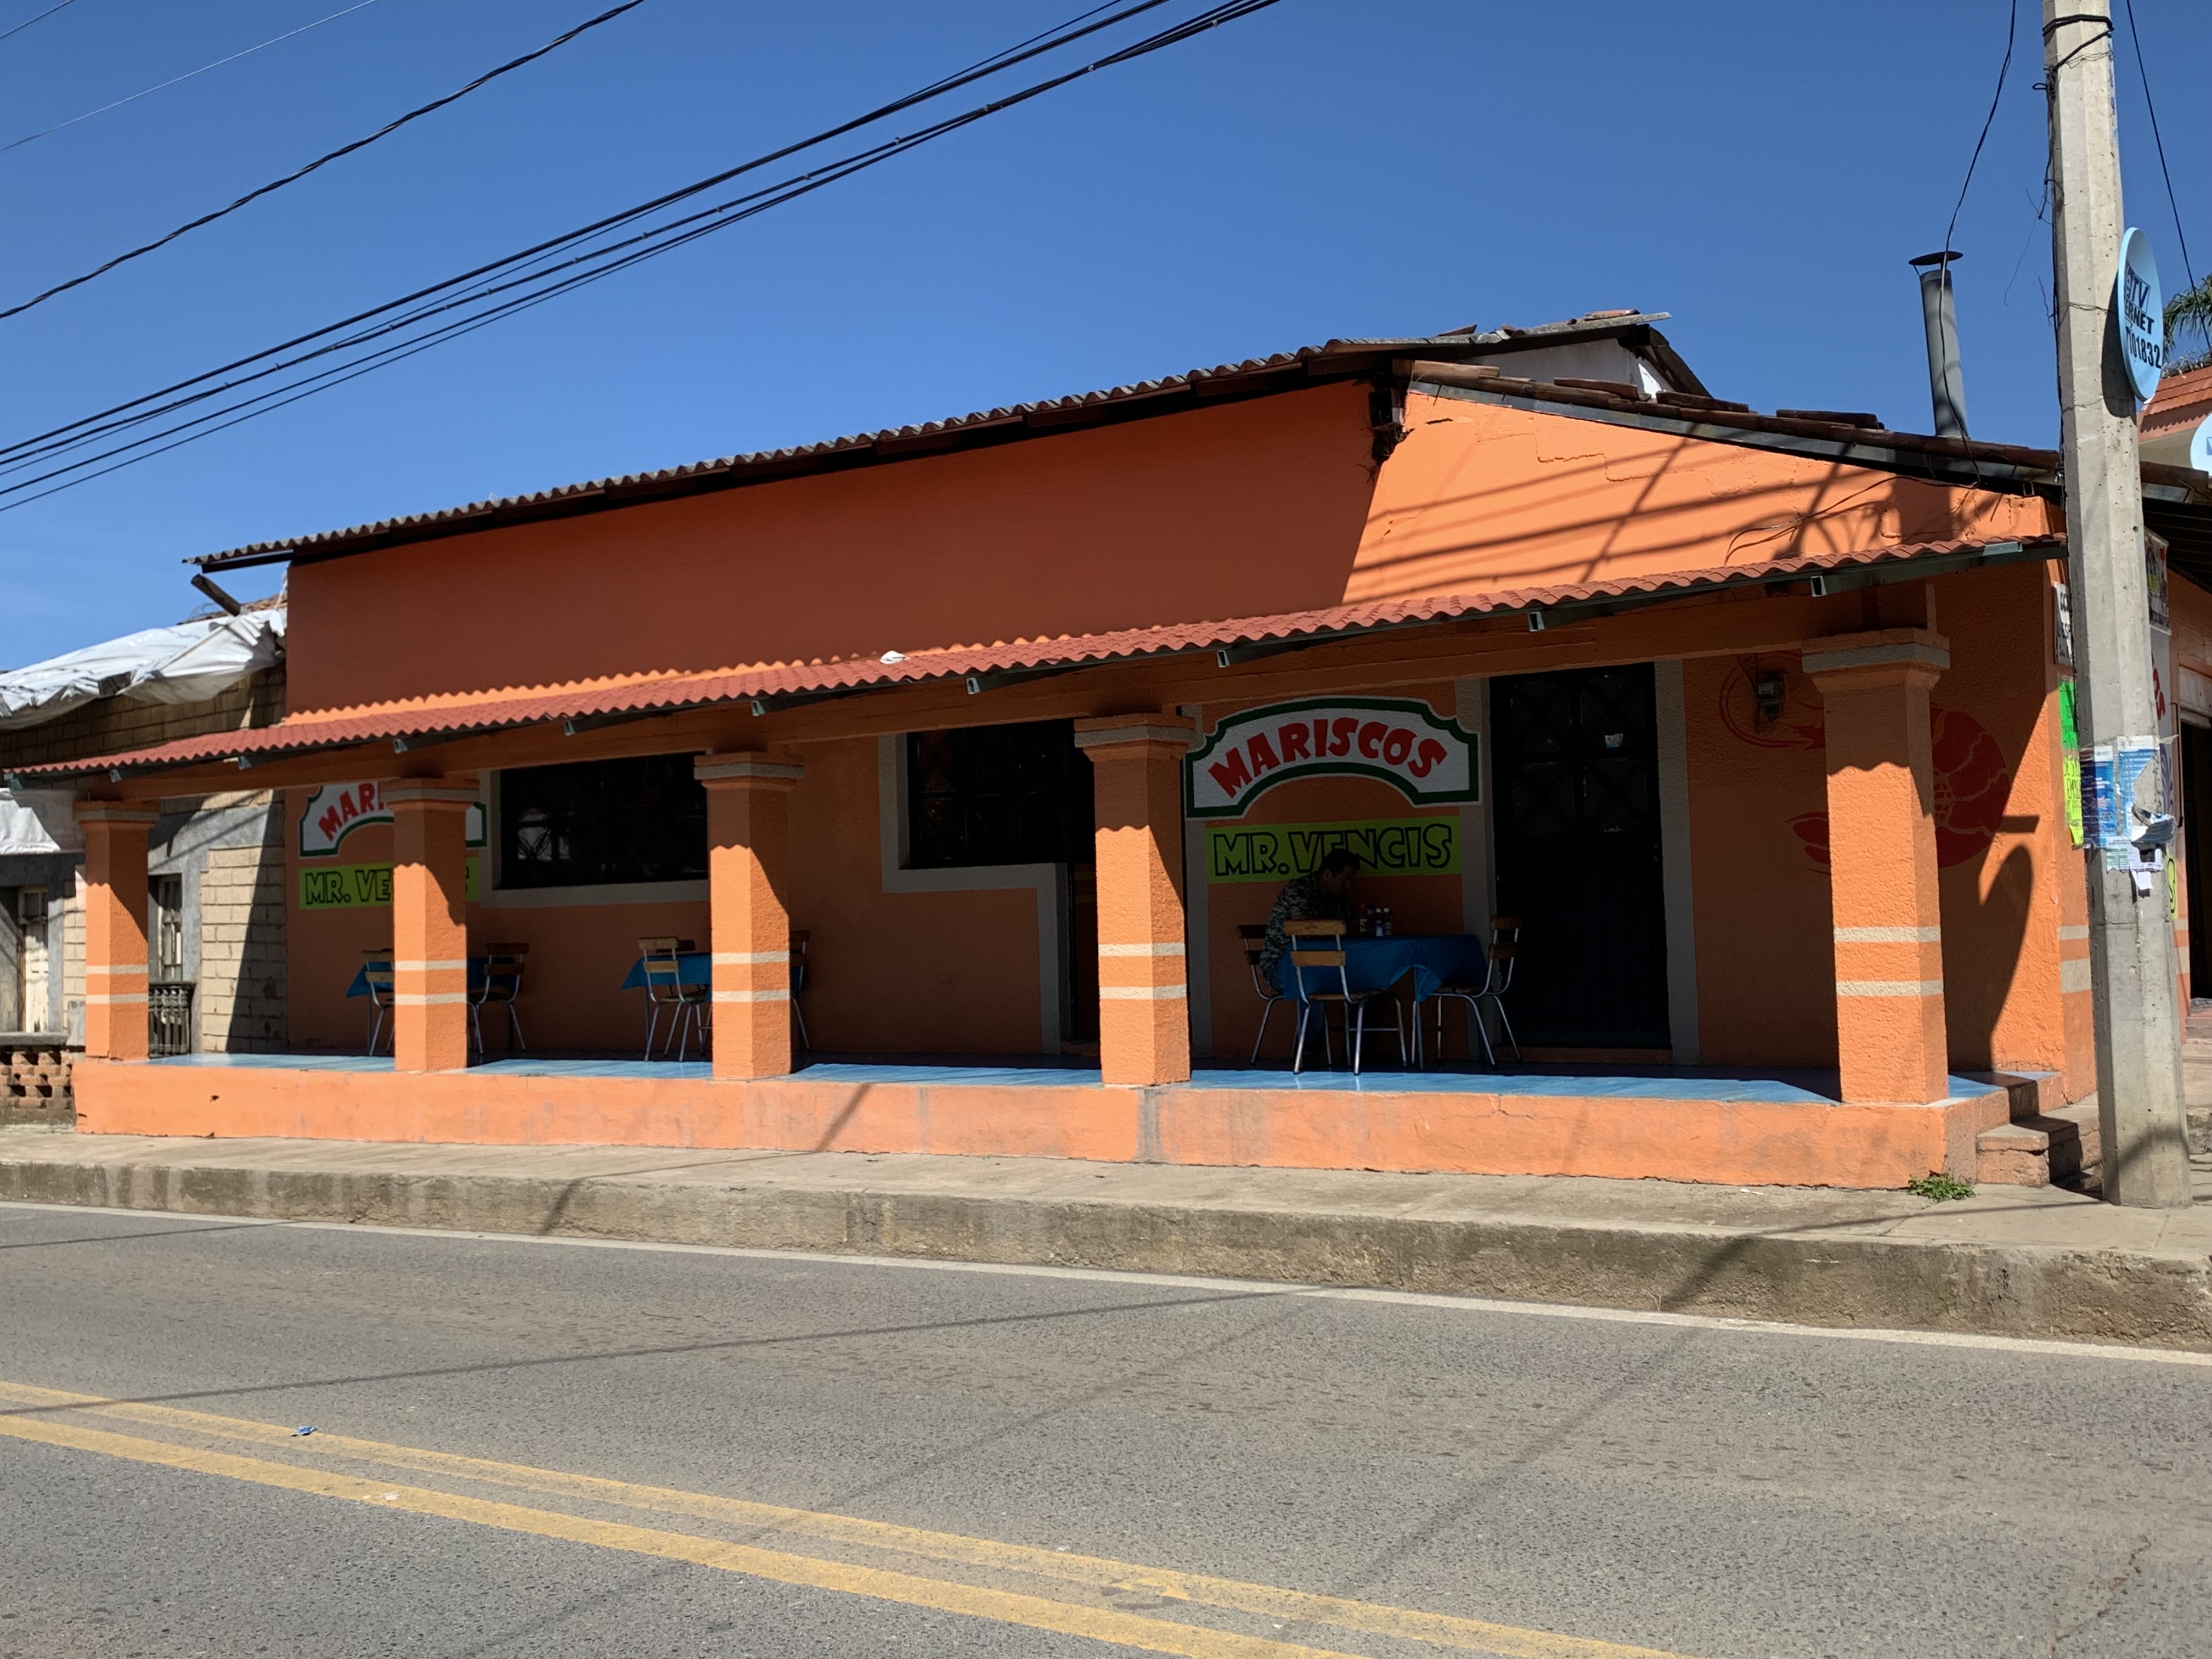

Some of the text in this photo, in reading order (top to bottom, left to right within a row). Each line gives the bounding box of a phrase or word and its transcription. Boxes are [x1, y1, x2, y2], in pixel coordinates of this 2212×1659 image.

[2125, 266, 2149, 308] eTV
[2125, 298, 2154, 335] ERNET
[1207, 716, 1448, 799] MARISCOS
[1214, 832, 1290, 877] MR.
[305, 871, 352, 905] MR.
